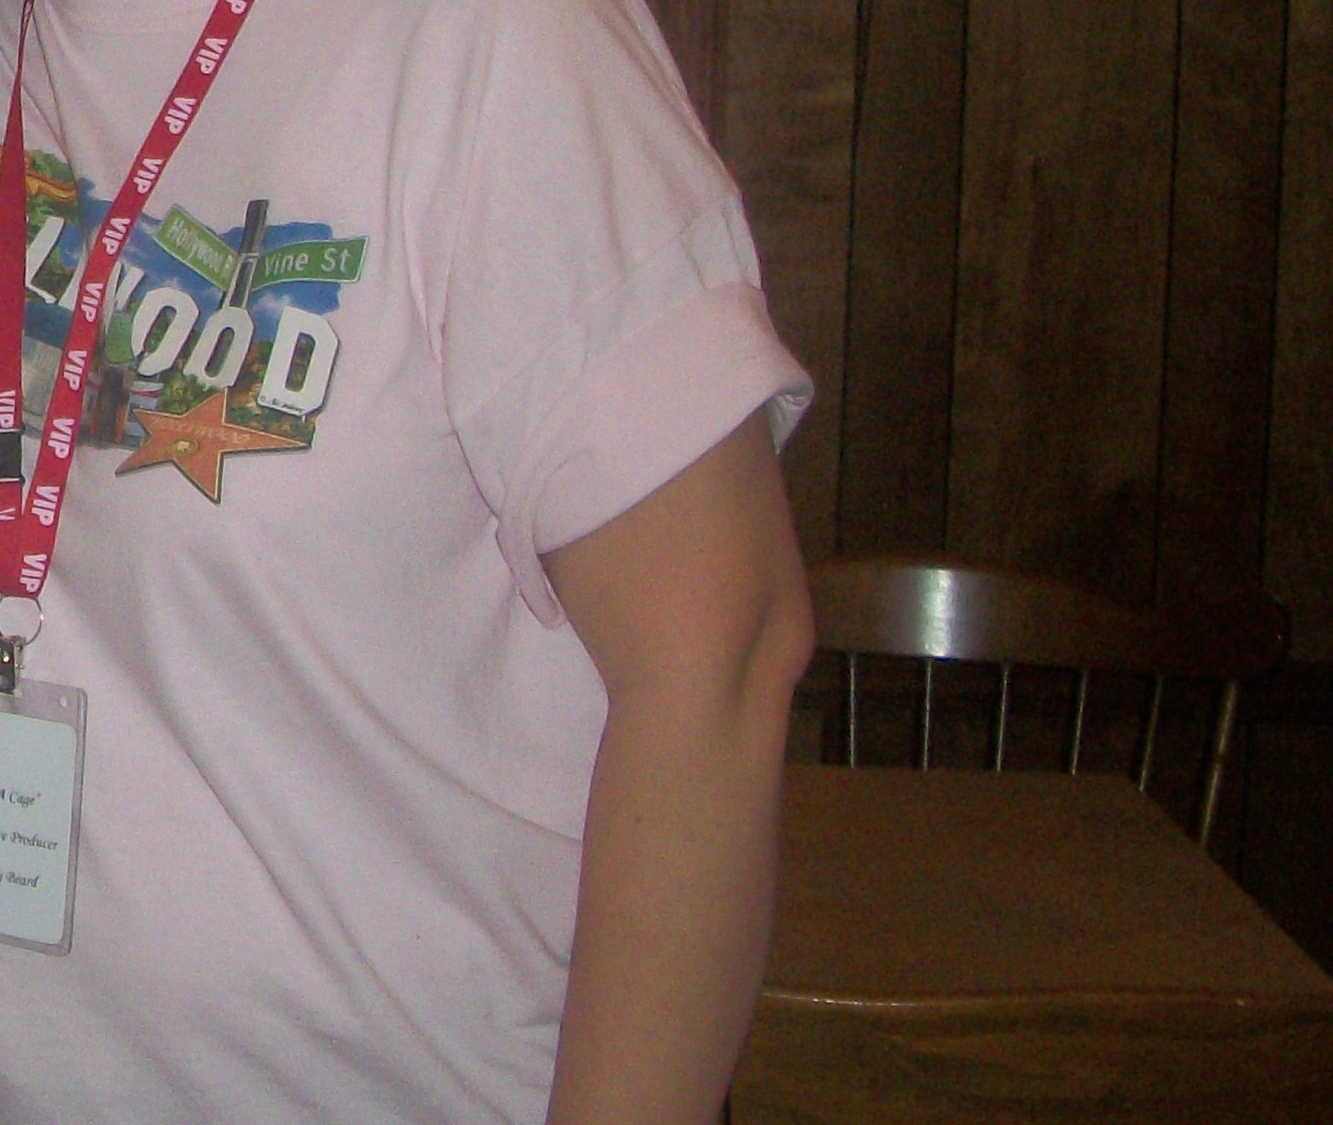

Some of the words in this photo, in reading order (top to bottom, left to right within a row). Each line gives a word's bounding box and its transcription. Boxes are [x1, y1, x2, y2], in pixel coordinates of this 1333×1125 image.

[195, 37, 228, 75] VIP
[164, 97, 197, 135] VIP
[134, 157, 164, 195] VIP
[101, 217, 131, 255] VIP
[265, 252, 309, 277] Vine
[321, 248, 351, 273] St
[81, 282, 104, 322] VIP
[63, 350, 87, 391] VIP
[47, 418, 75, 459] VIP
[31, 485, 60, 526] VIP
[19, 553, 47, 593] VIP
[12, 831, 59, 851] Producer
